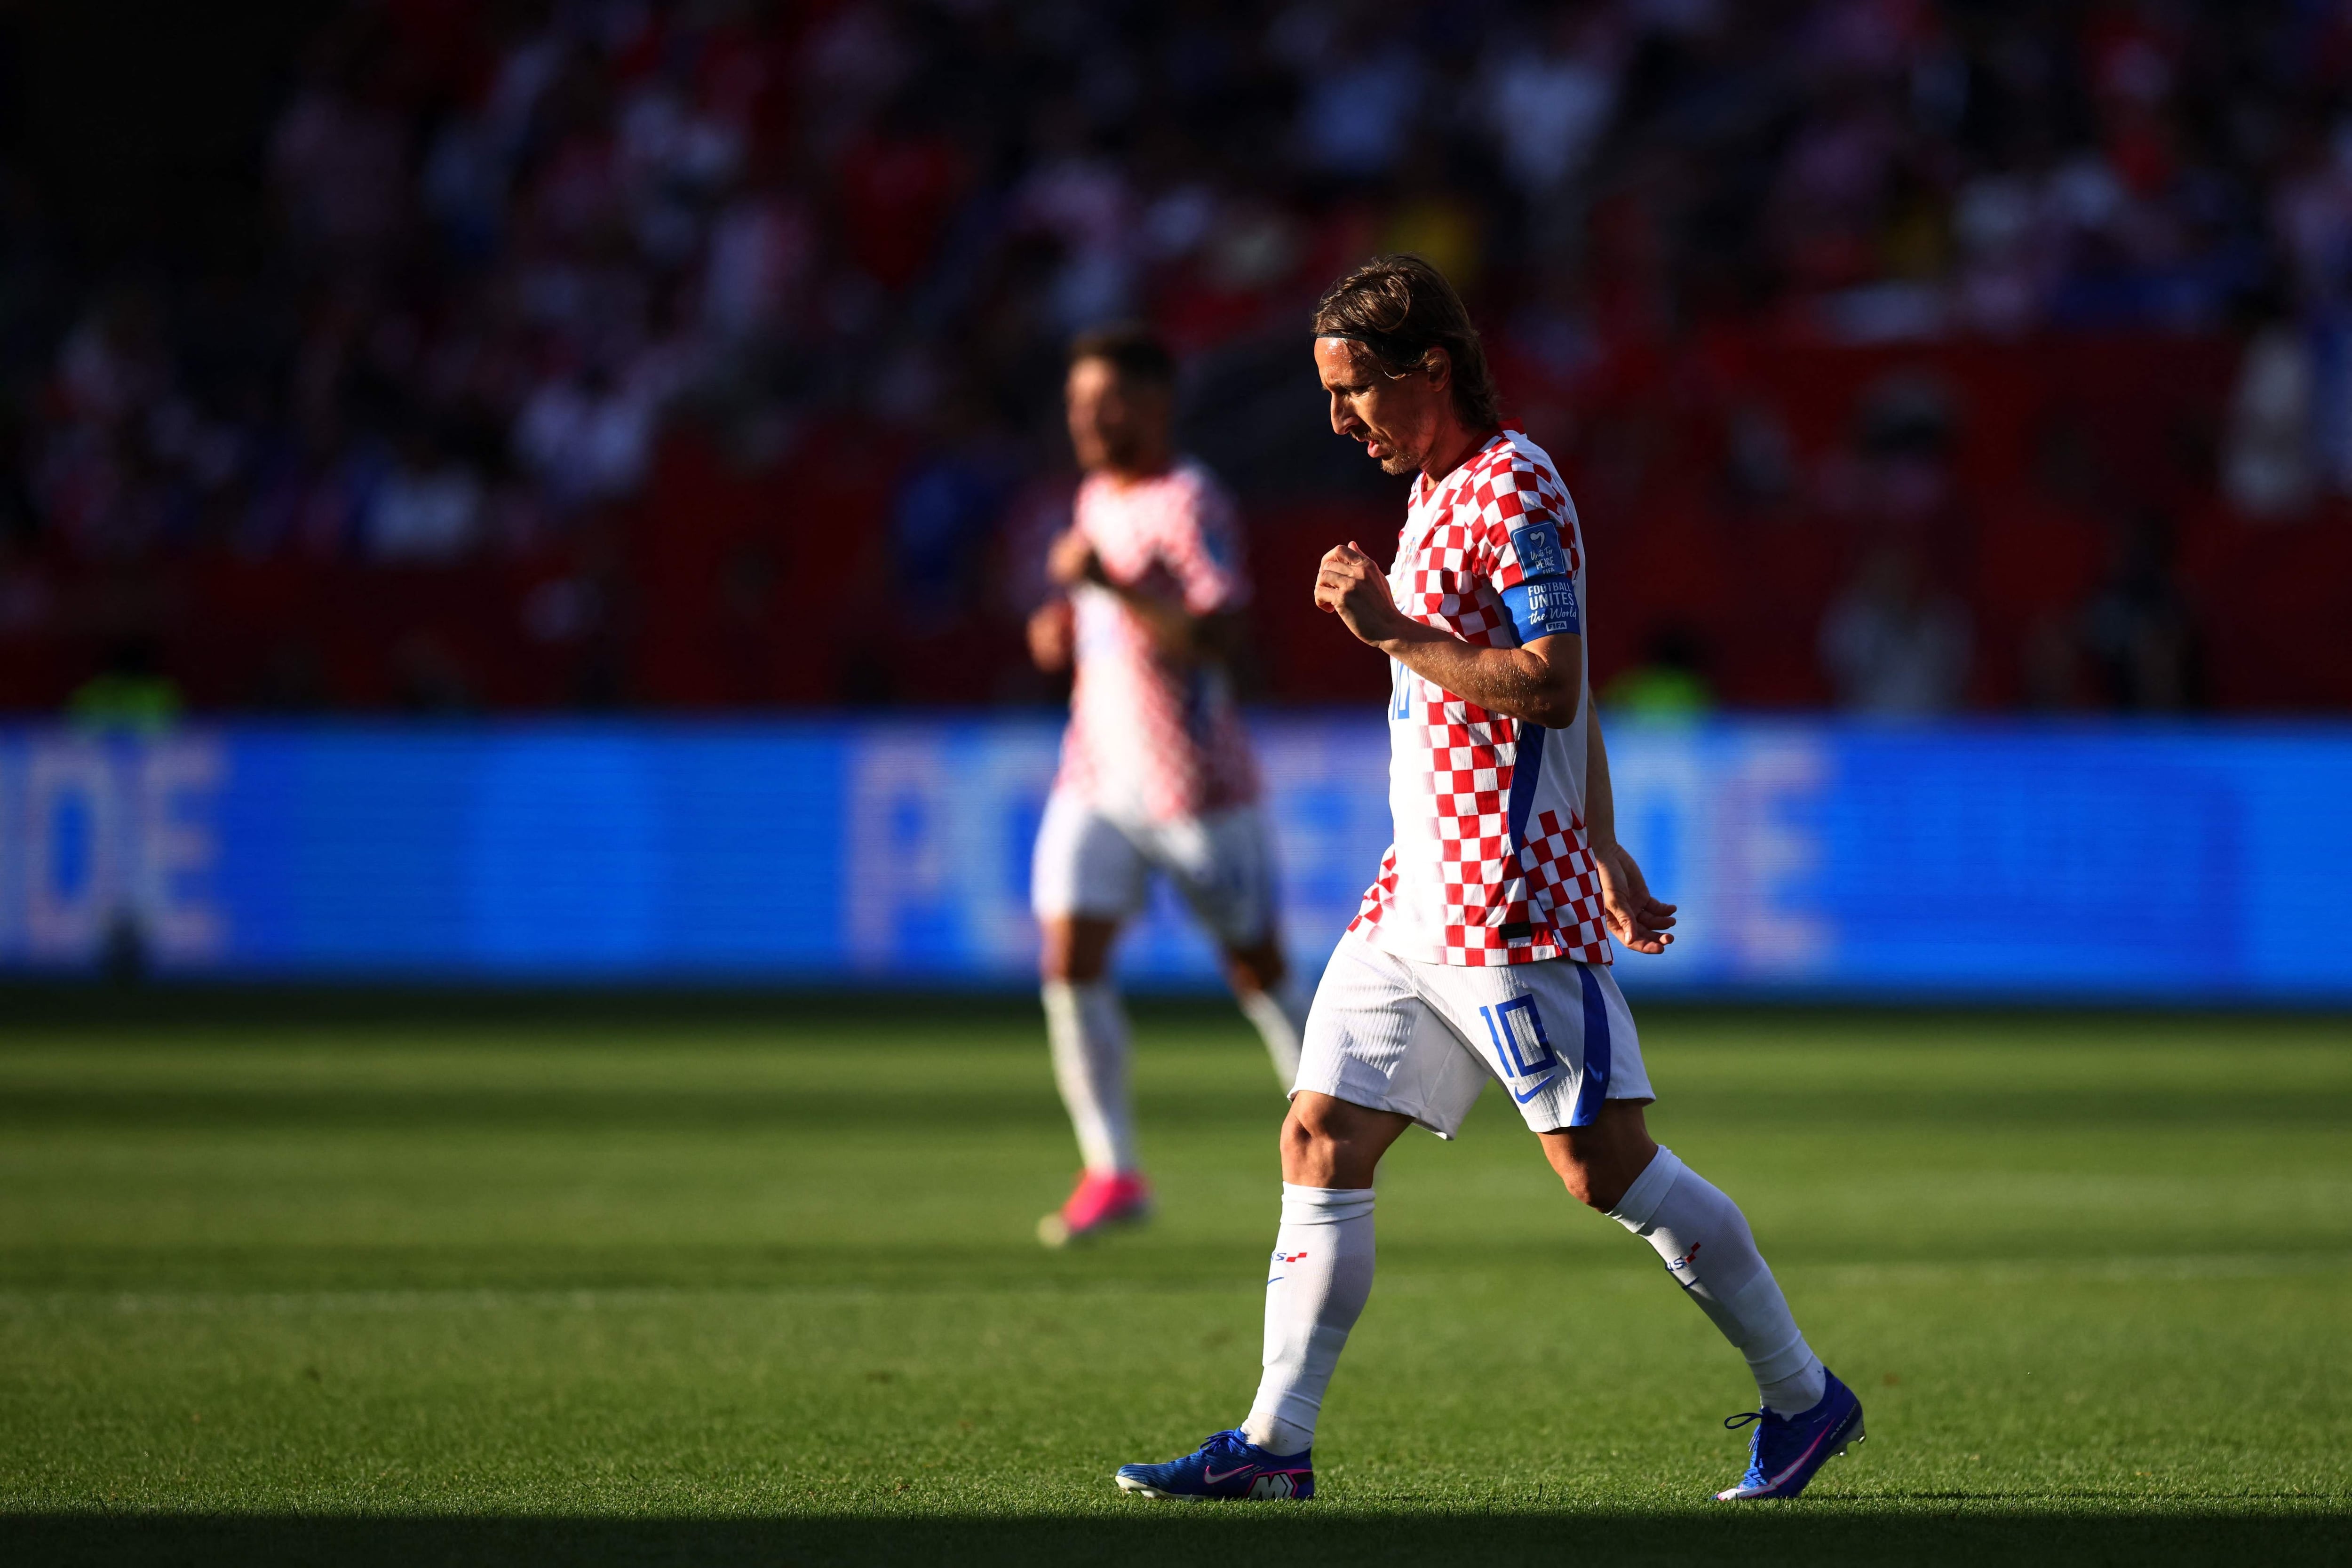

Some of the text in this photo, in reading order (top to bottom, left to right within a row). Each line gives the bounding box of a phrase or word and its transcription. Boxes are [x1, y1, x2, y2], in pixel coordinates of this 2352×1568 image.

[1530, 546, 1553, 560] Unite For
[1534, 557, 1554, 570] PEACE
[1528, 582, 1571, 597] FOOTBALL
[1529, 592, 1574, 610] UNITES
[1528, 606, 1577, 625] the World
[1479, 994, 1557, 1077] 10
